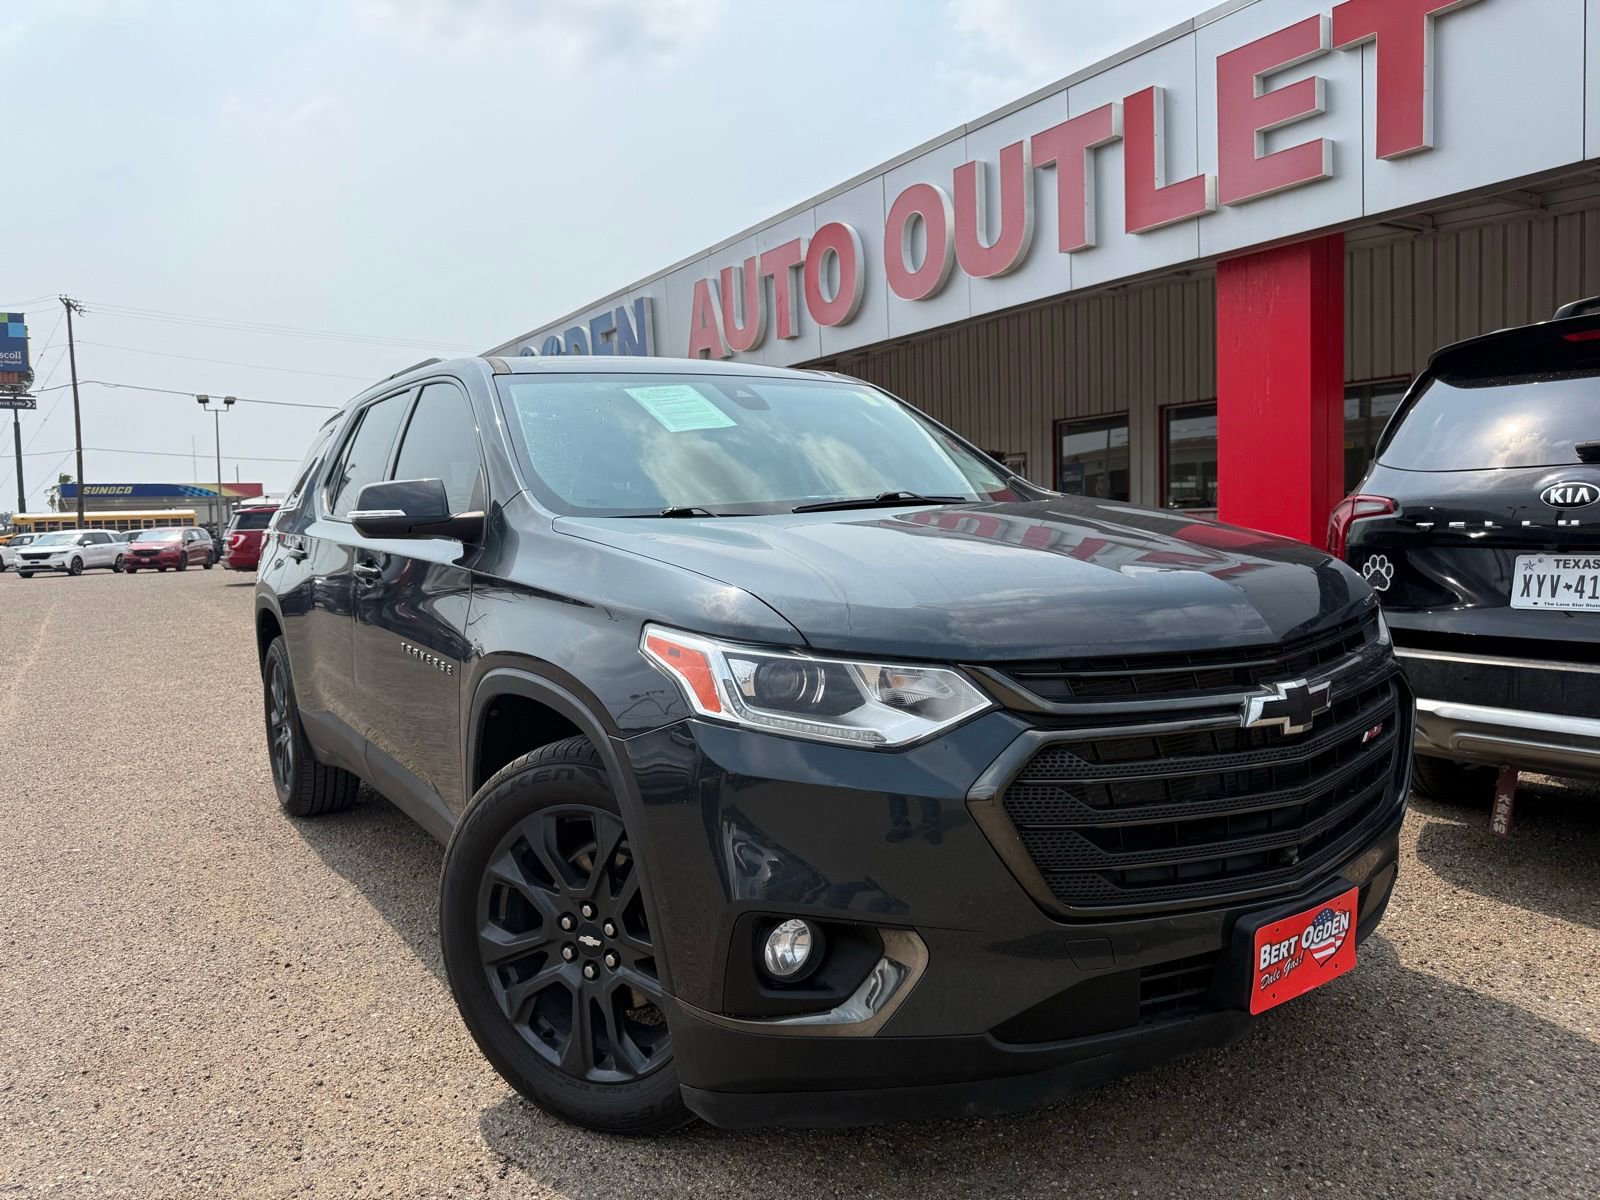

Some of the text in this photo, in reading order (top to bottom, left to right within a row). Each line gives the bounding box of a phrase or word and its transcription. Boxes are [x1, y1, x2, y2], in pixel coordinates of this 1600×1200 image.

[688, 221, 865, 360] AUTO
[884, 0, 1480, 301] OUTLET
[83, 486, 133, 495] SUNOCO
[1549, 487, 1591, 504] KIA
[1554, 558, 1600, 570] TEXAS
[1520, 574, 1561, 599] XYV
[401, 642, 455, 676] TRAVERSE
[1259, 911, 1350, 971] BERT OGDEN
